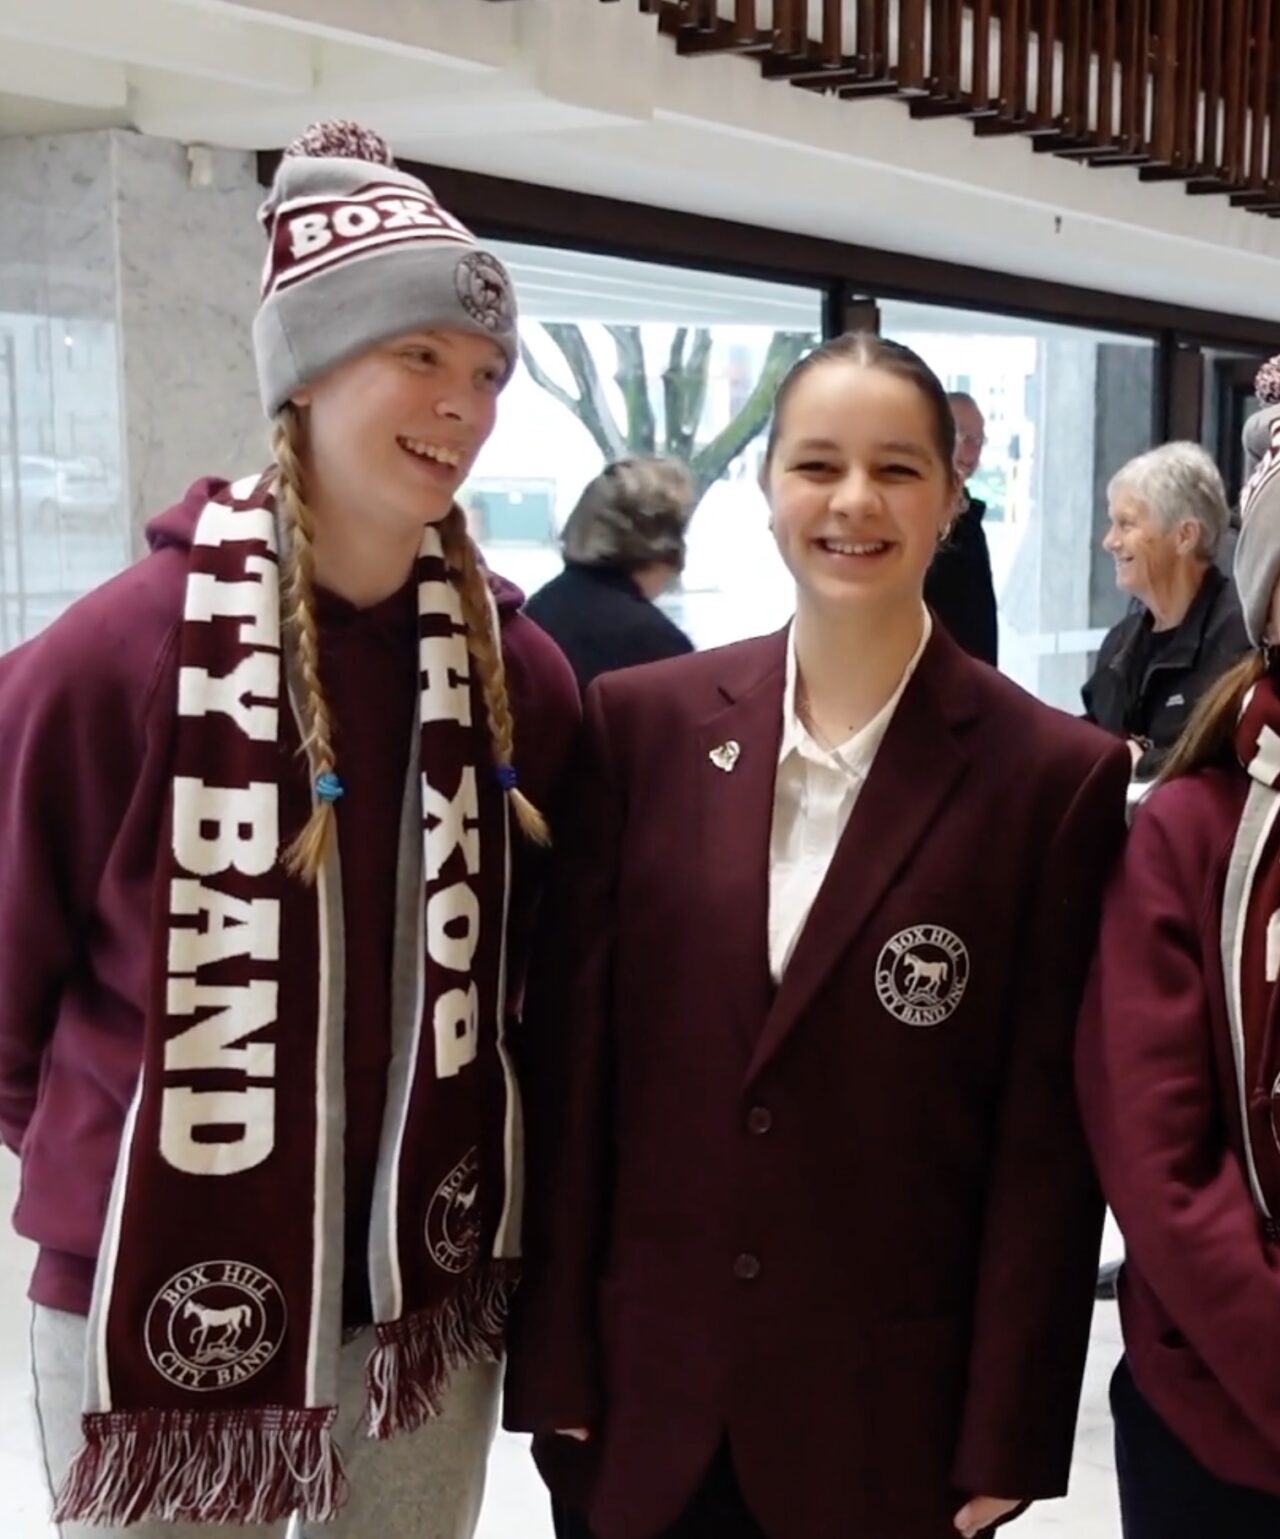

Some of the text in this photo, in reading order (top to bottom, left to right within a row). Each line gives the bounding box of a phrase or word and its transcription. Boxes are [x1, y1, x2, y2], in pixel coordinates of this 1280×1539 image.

[288, 199, 443, 260] BOX
[421, 765, 480, 1079] BOX
[888, 928, 964, 961] BOX HILL
[159, 776, 280, 1175] BAND
[880, 970, 905, 1011] CITY
[900, 1004, 945, 1023] BAND
[160, 1264, 272, 1307] BOX HILL
[157, 1340, 274, 1387] CITY BAND
